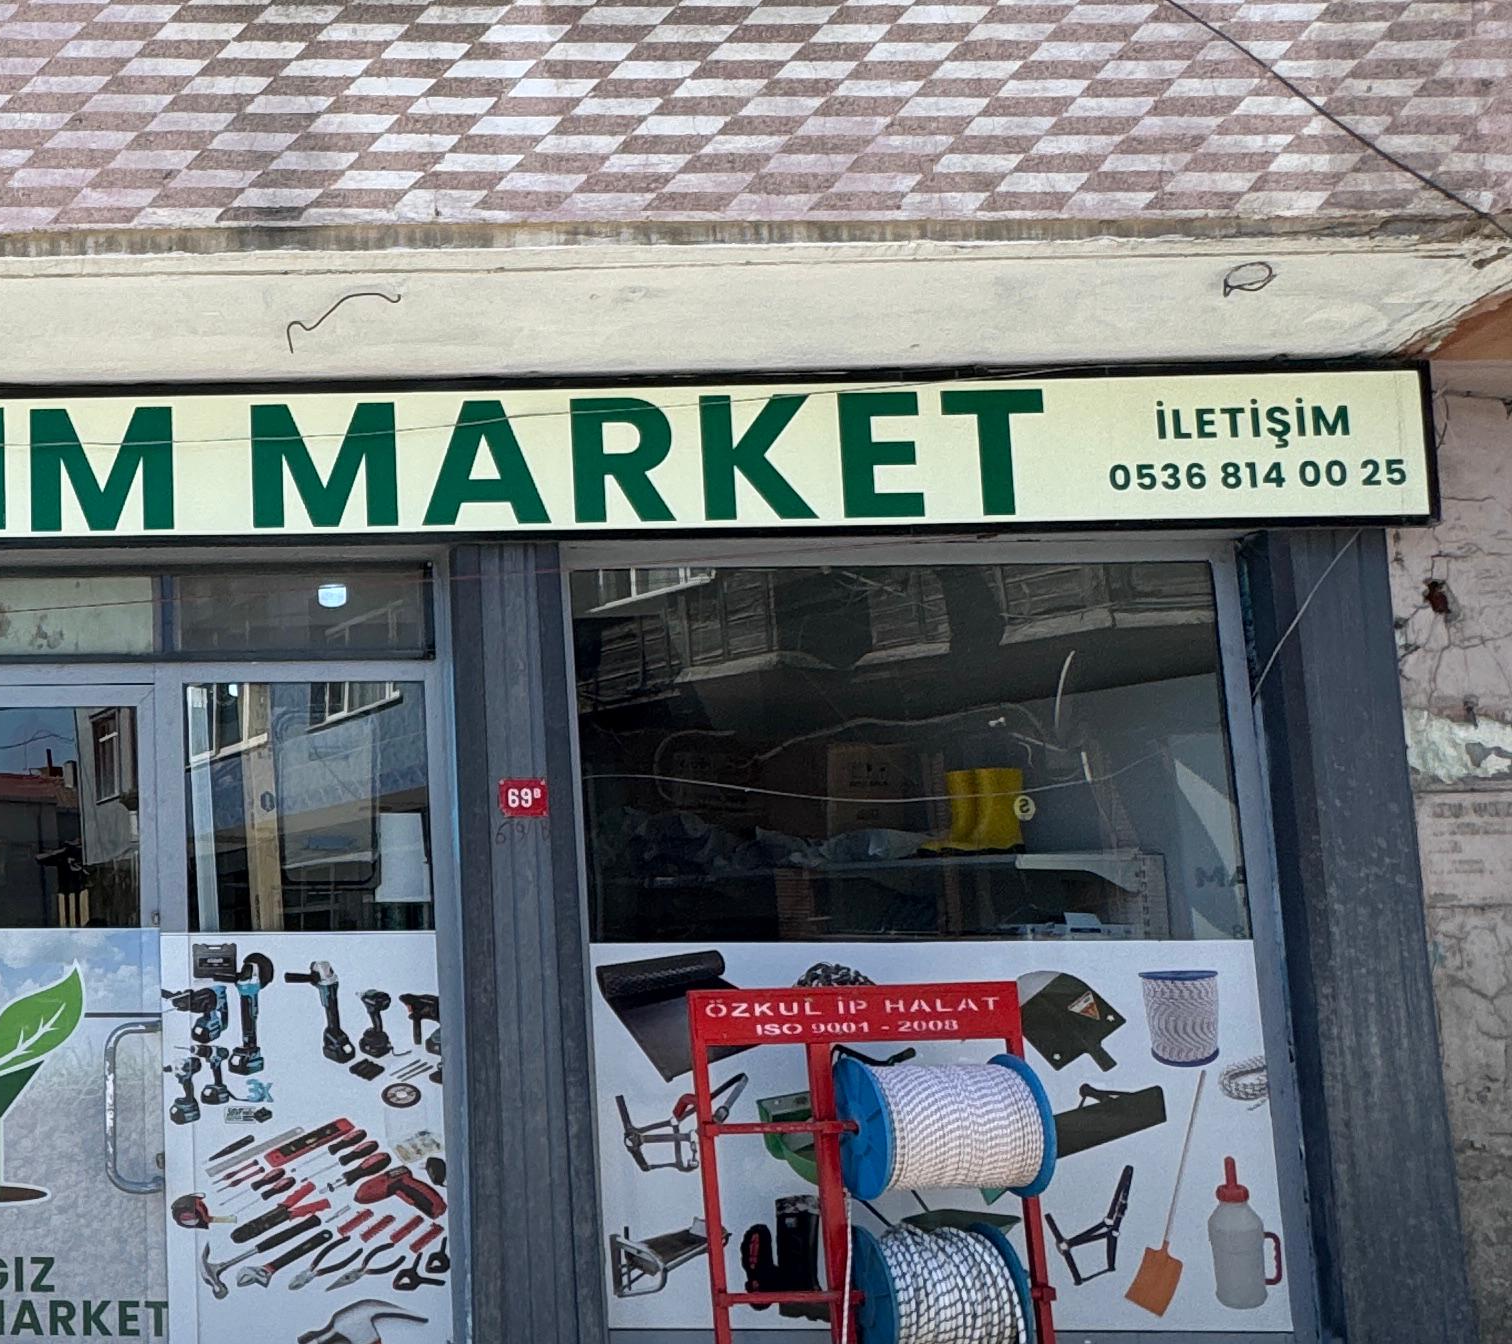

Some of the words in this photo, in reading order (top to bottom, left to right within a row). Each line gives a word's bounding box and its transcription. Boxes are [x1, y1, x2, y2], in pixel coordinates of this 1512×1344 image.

[1155, 397, 1351, 449] İLETİŞİM
[250, 387, 1045, 529] MARKET
[1109, 462, 1207, 491] 0536
[1220, 461, 1286, 490] 814
[1298, 460, 1348, 488] 00
[1360, 458, 1407, 487] 25
[704, 999, 822, 1018] ÖZKUL
[837, 996, 869, 1015] İP
[884, 996, 1000, 1014] HALAT
[755, 1023, 803, 1036] ISO
[811, 1021, 870, 1035] 9001
[897, 1019, 960, 1033] 2008
